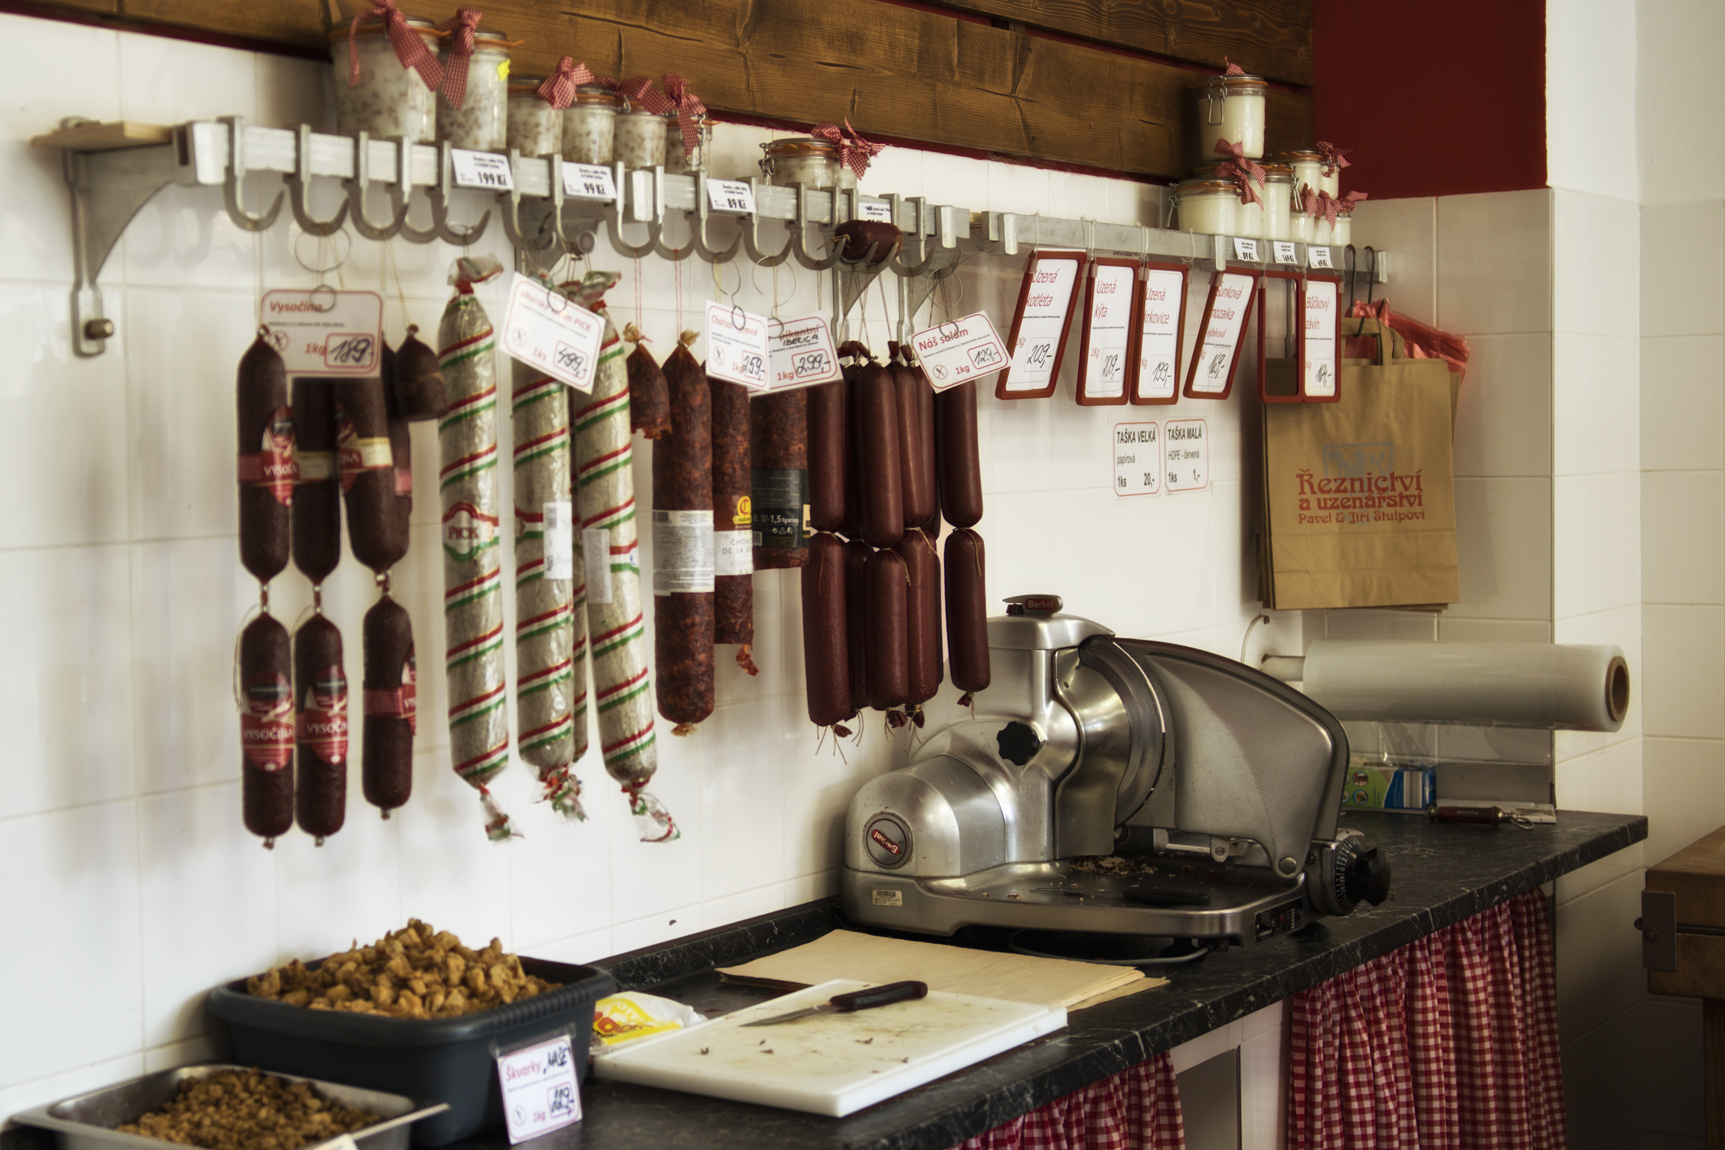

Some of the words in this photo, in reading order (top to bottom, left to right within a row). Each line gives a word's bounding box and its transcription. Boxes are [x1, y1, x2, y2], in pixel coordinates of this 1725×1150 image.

[477, 171, 495, 184] 199
[496, 172, 508, 186] Kč
[584, 182, 595, 194] 99
[596, 183, 606, 196] Kč
[726, 198, 738, 209] 89
[738, 199, 747, 210] Kč
[1096, 278, 1118, 294] Uzená
[269, 300, 324, 314] Vysočina
[574, 316, 592, 332] PICK
[711, 314, 734, 329] Chorizo
[918, 336, 938, 352] Náš
[940, 328, 969, 344] salám
[777, 371, 794, 381] 1kg
[955, 365, 970, 375] 1kg
[1116, 429, 1136, 444] TAŠKA
[1137, 427, 1156, 442] VELKÁ
[1168, 426, 1186, 440] TAŠKA
[1186, 424, 1202, 439] MALÁ
[1296, 468, 1422, 495] Řeznictví
[1298, 497, 1311, 511] a
[1316, 489, 1424, 510] uzenářství
[1298, 512, 1332, 524] Pavel
[1336, 512, 1345, 523] &
[1348, 510, 1370, 524] Jiří
[1374, 509, 1426, 523] Štulpovi
[448, 525, 480, 540] PICK
[1028, 600, 1054, 609] Berkel
[242, 726, 294, 741] VYSOČINA
[873, 831, 898, 854] Berkel
[506, 1060, 542, 1082] Škvarky
